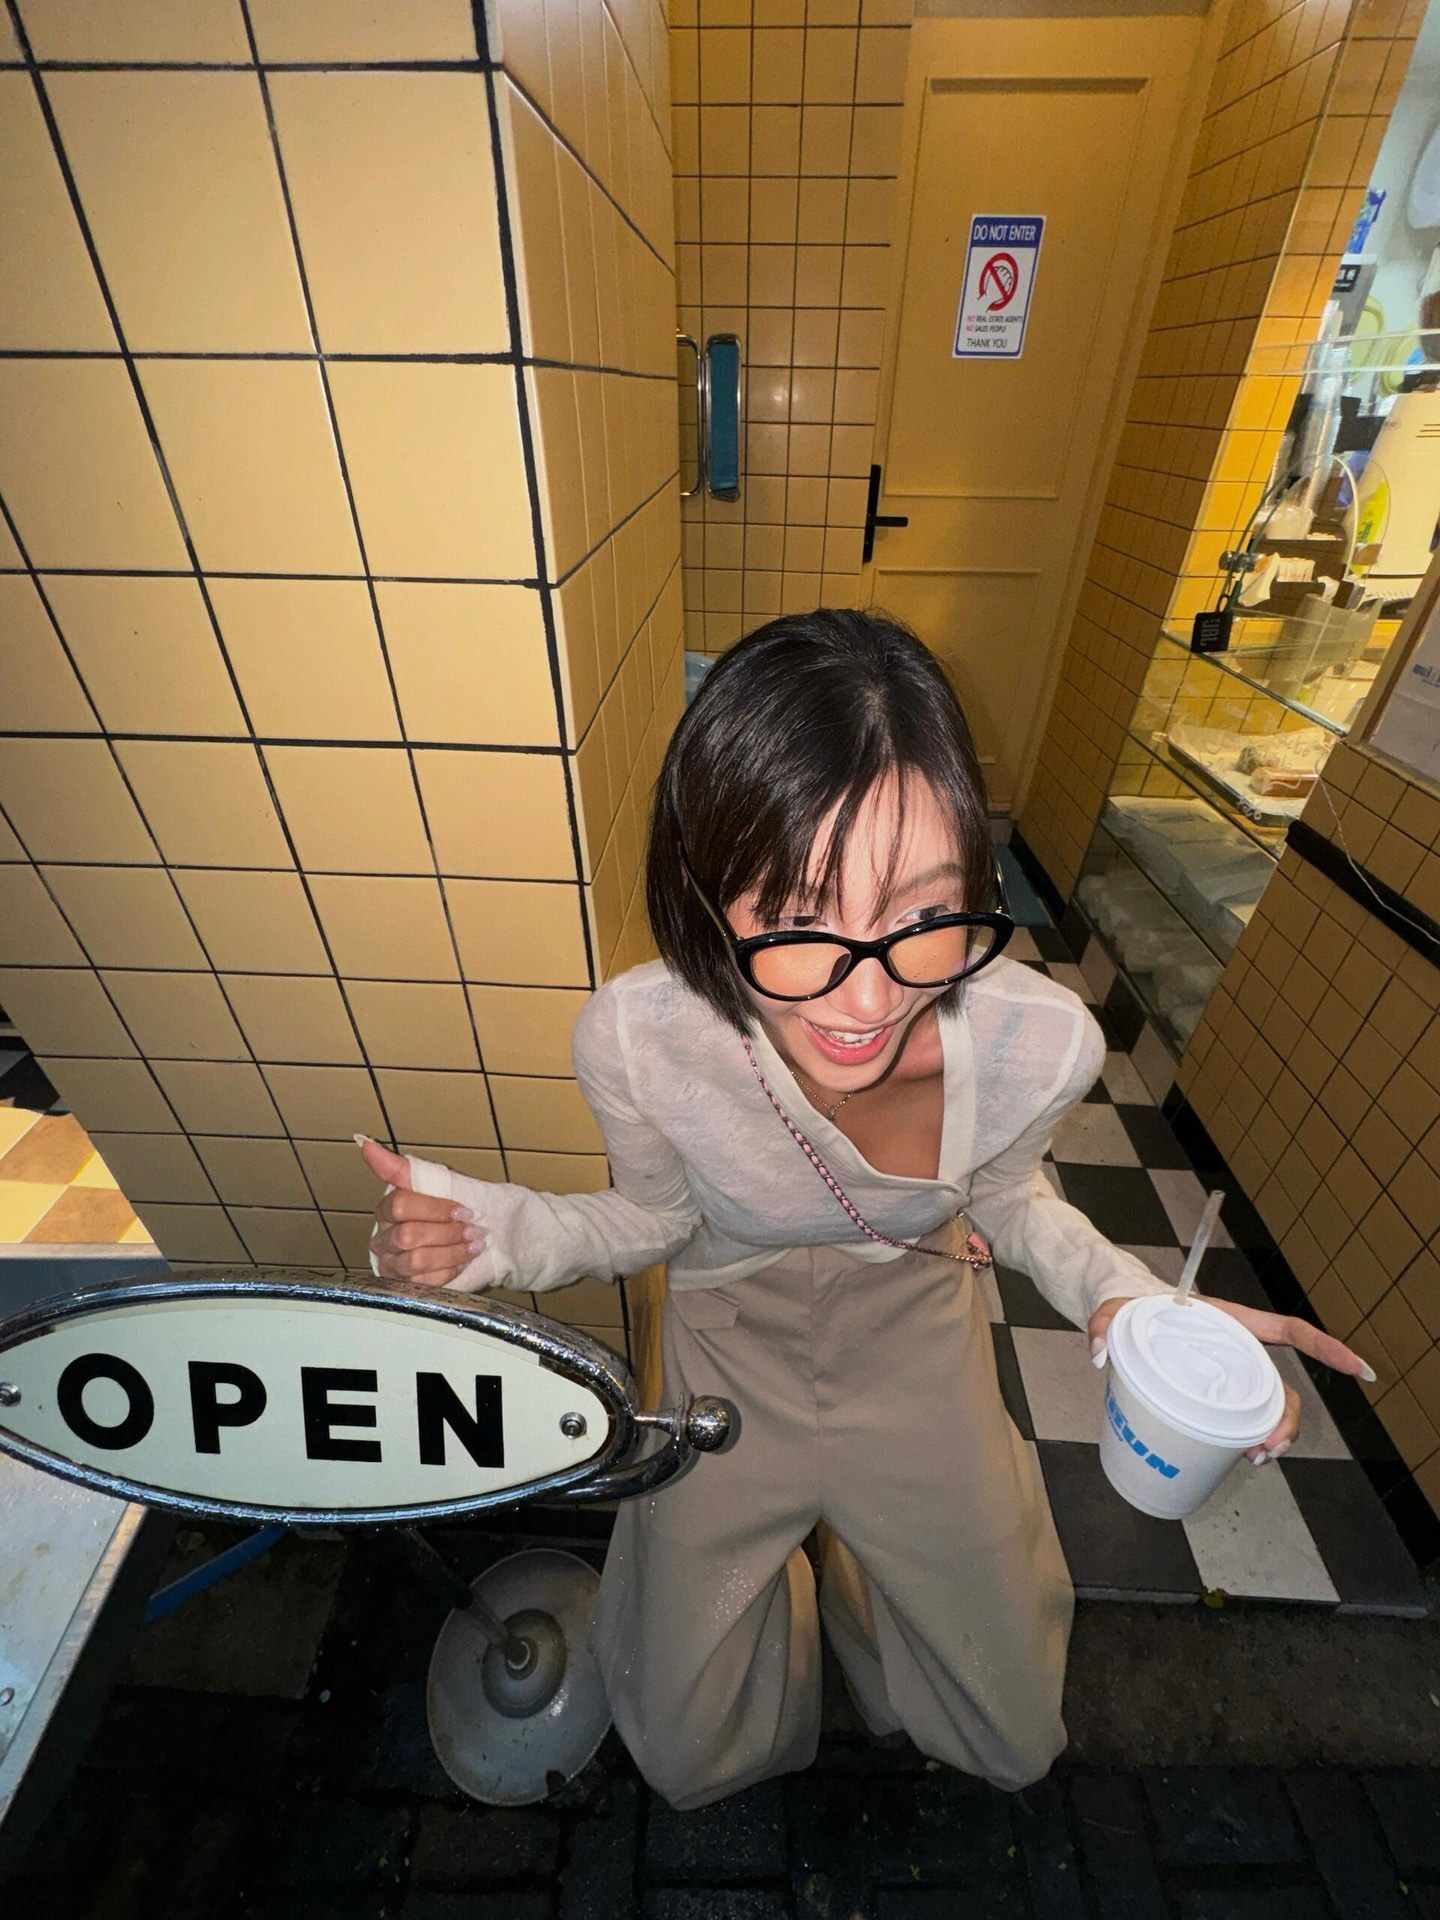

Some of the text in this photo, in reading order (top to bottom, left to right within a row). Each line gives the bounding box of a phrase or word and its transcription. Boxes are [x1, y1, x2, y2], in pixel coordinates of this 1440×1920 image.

[974, 224, 1036, 241] DO NOT ENTER
[967, 315, 975, 323] NO
[976, 315, 988, 323] REAL
[988, 315, 1004, 323] ESTATE
[975, 325, 989, 333] SALES
[990, 325, 1006, 333] PEOPLE
[967, 338, 1007, 348] THANK YOU
[1200, 619, 1220, 647] JBL
[57, 1353, 505, 1469] OPEN
